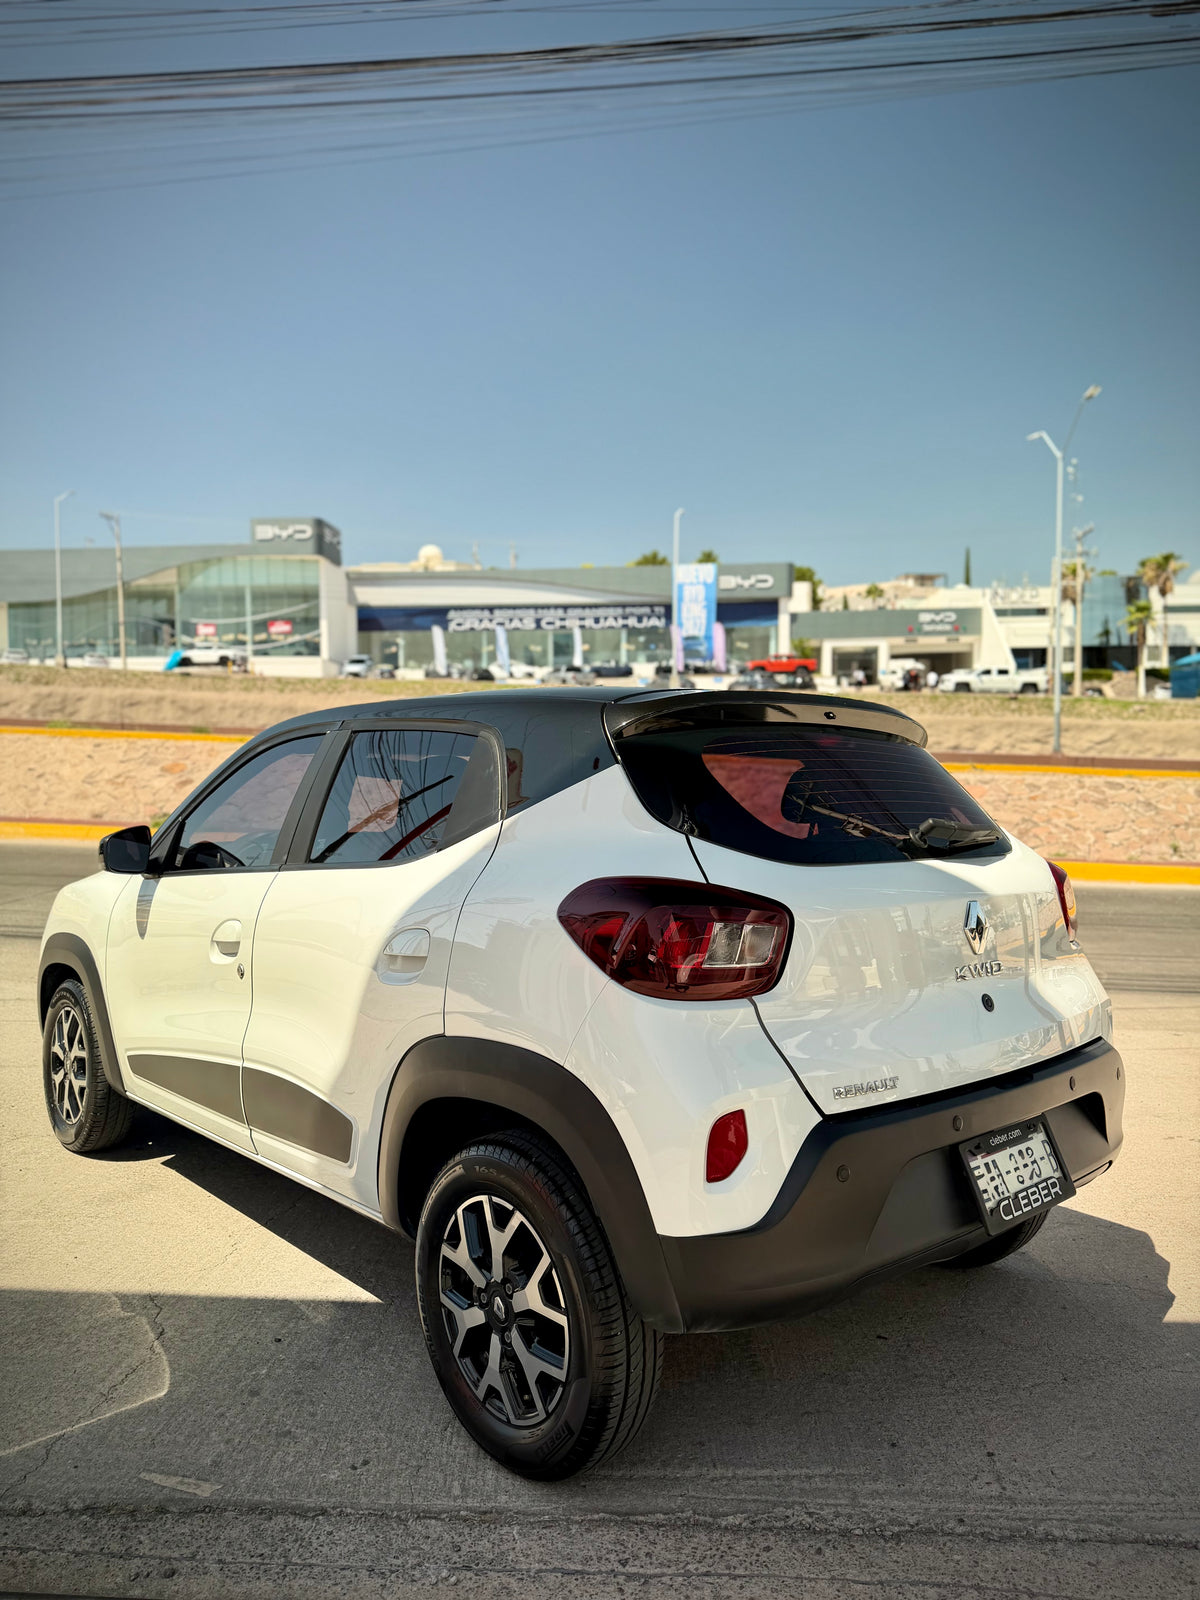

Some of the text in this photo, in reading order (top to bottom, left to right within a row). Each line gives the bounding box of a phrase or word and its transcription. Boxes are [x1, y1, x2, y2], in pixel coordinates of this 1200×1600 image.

[254, 524, 313, 541] BYD
[718, 574, 774, 590] BYD
[918, 612, 957, 623] BYD
[955, 960, 1005, 982] KWID
[832, 1075, 900, 1100] RENAULT
[989, 1128, 1023, 1146] cleber.com
[1000, 1177, 1063, 1221] CLEBER
